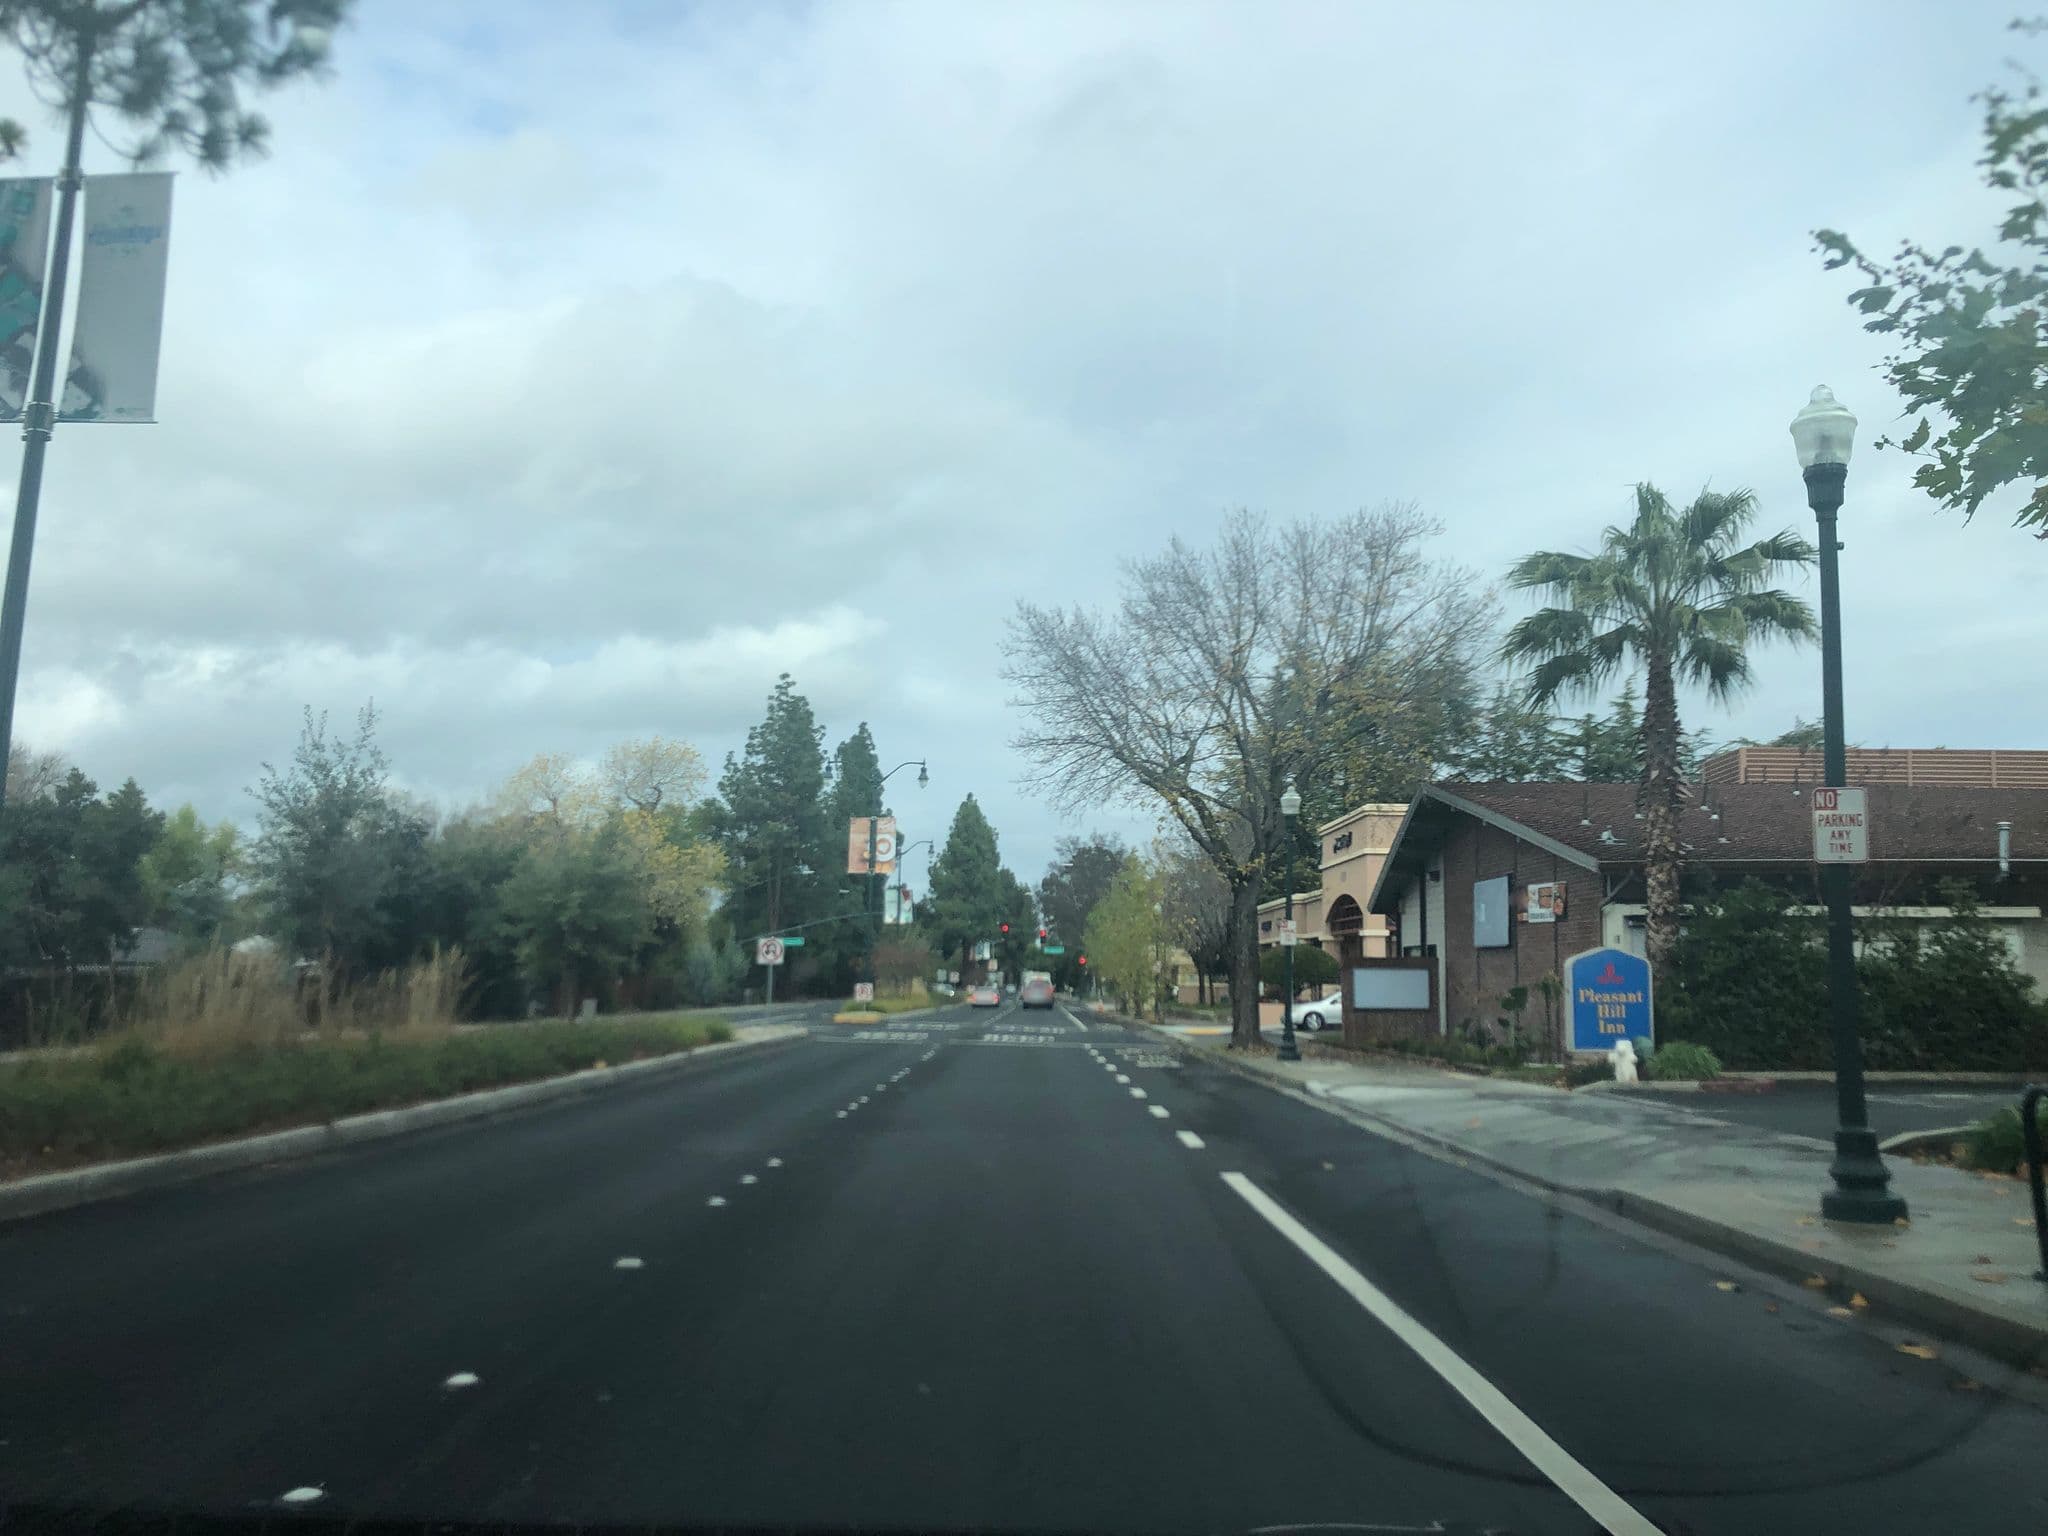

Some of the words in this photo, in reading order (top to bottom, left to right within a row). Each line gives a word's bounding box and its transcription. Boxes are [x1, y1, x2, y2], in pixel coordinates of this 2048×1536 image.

[1816, 791, 1835, 807] NO
[1818, 813, 1862, 827] PARKING
[1830, 829, 1851, 841] ANY
[1829, 843, 1853, 854] TIME
[1579, 987, 1642, 1003] Pleasant
[1599, 1003, 1626, 1017] Hill
[1599, 1019, 1626, 1033] Inn
